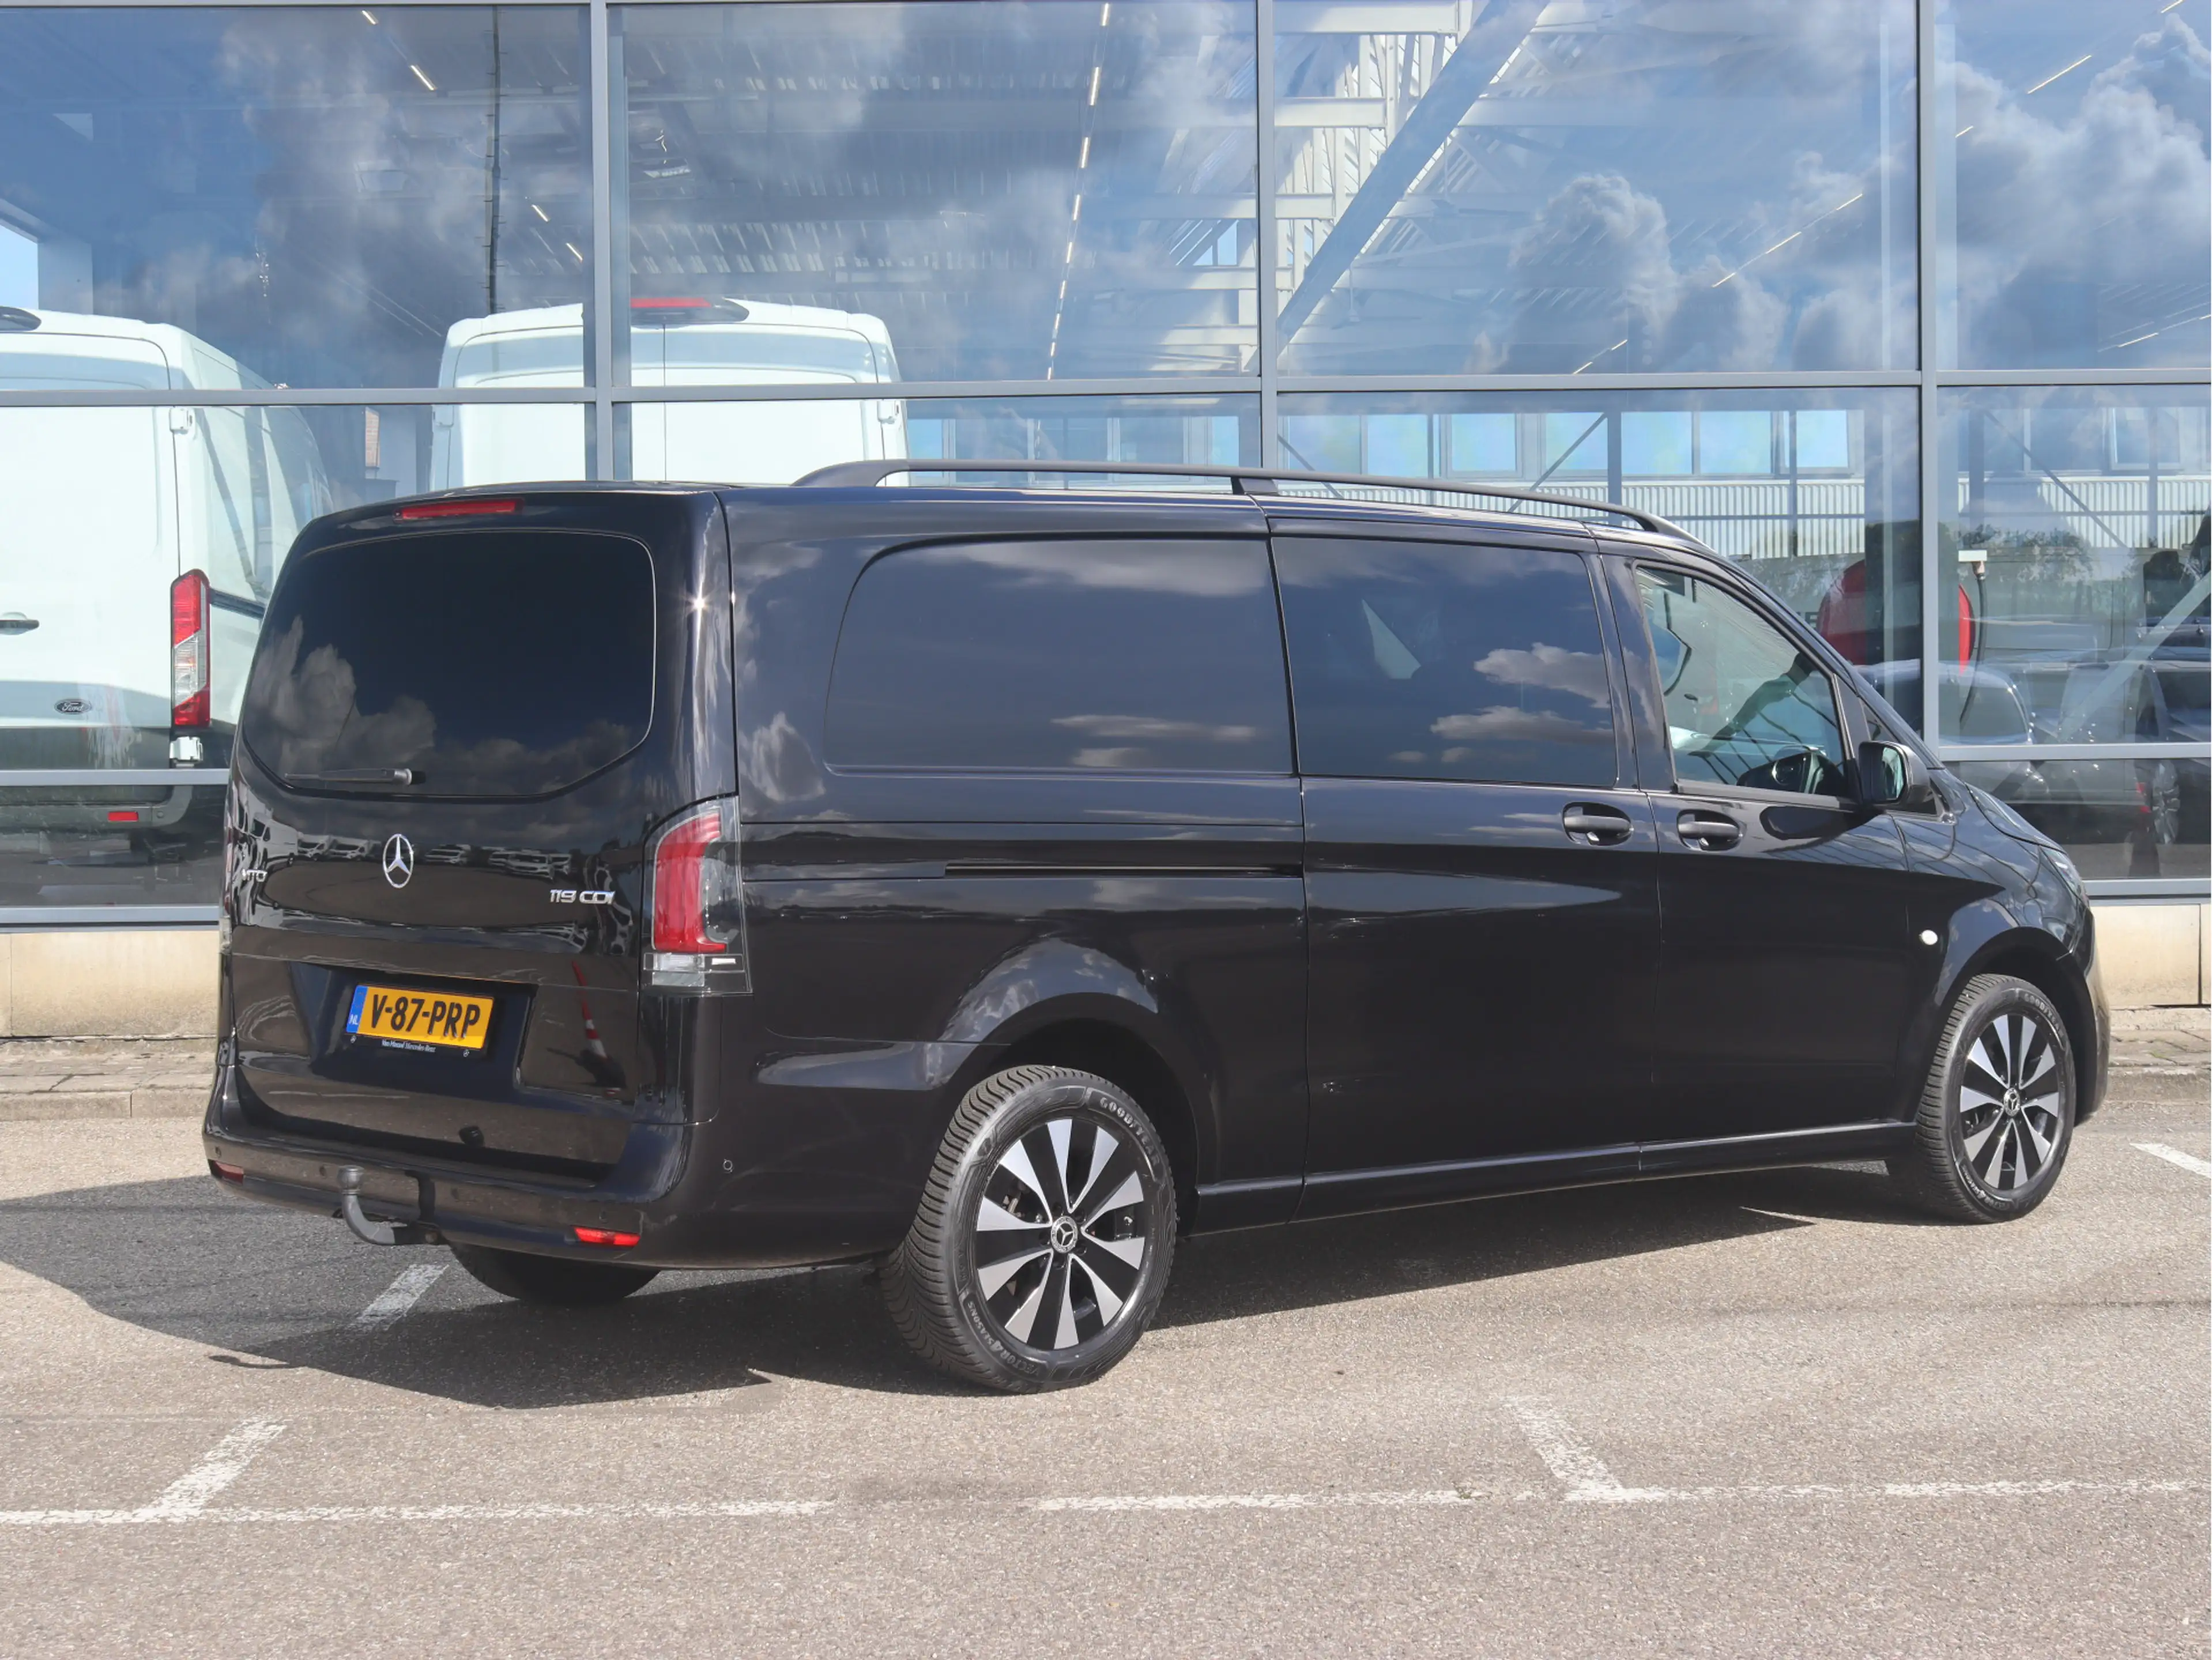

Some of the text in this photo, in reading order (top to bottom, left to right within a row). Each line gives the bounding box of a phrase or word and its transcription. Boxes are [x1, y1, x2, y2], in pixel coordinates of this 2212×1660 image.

[62, 701, 84, 712] Ford
[550, 889, 615, 905] 119 CDI
[349, 1014, 358, 1025] NL
[371, 994, 480, 1038] V-87-PRP
[1100, 1097, 1160, 1165] GOODYEAR
